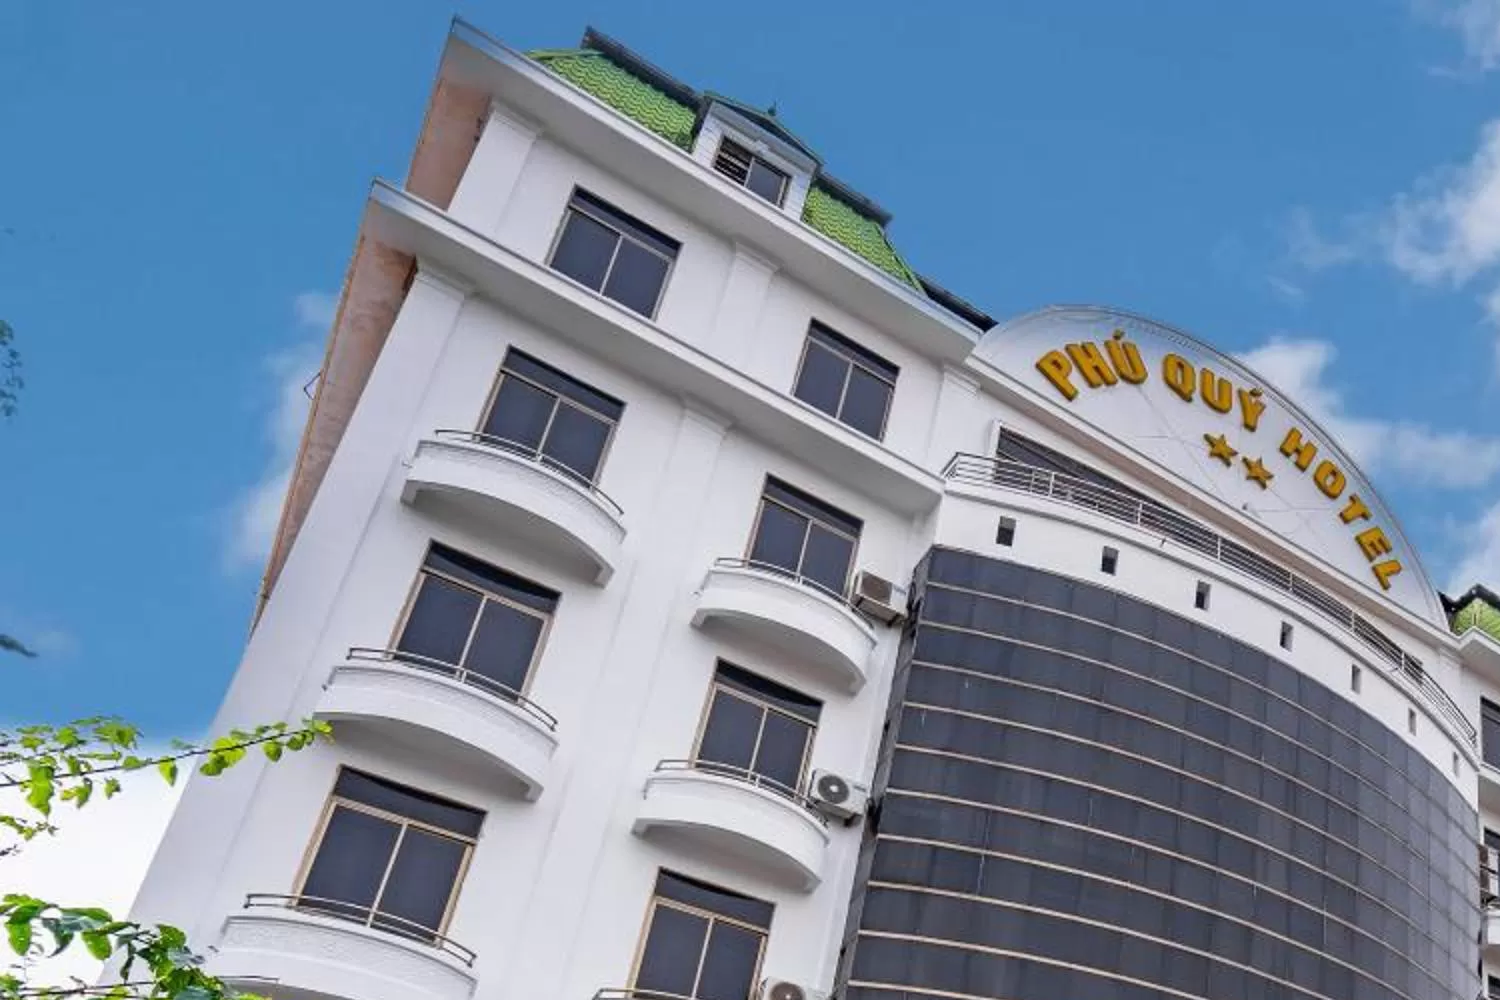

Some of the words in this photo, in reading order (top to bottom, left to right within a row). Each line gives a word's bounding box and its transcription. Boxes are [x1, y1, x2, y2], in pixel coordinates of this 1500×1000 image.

[1035, 328, 1149, 402] PHÚ
[1163, 352, 1267, 433] QUÝ
[1279, 427, 1404, 591] HOTEL
